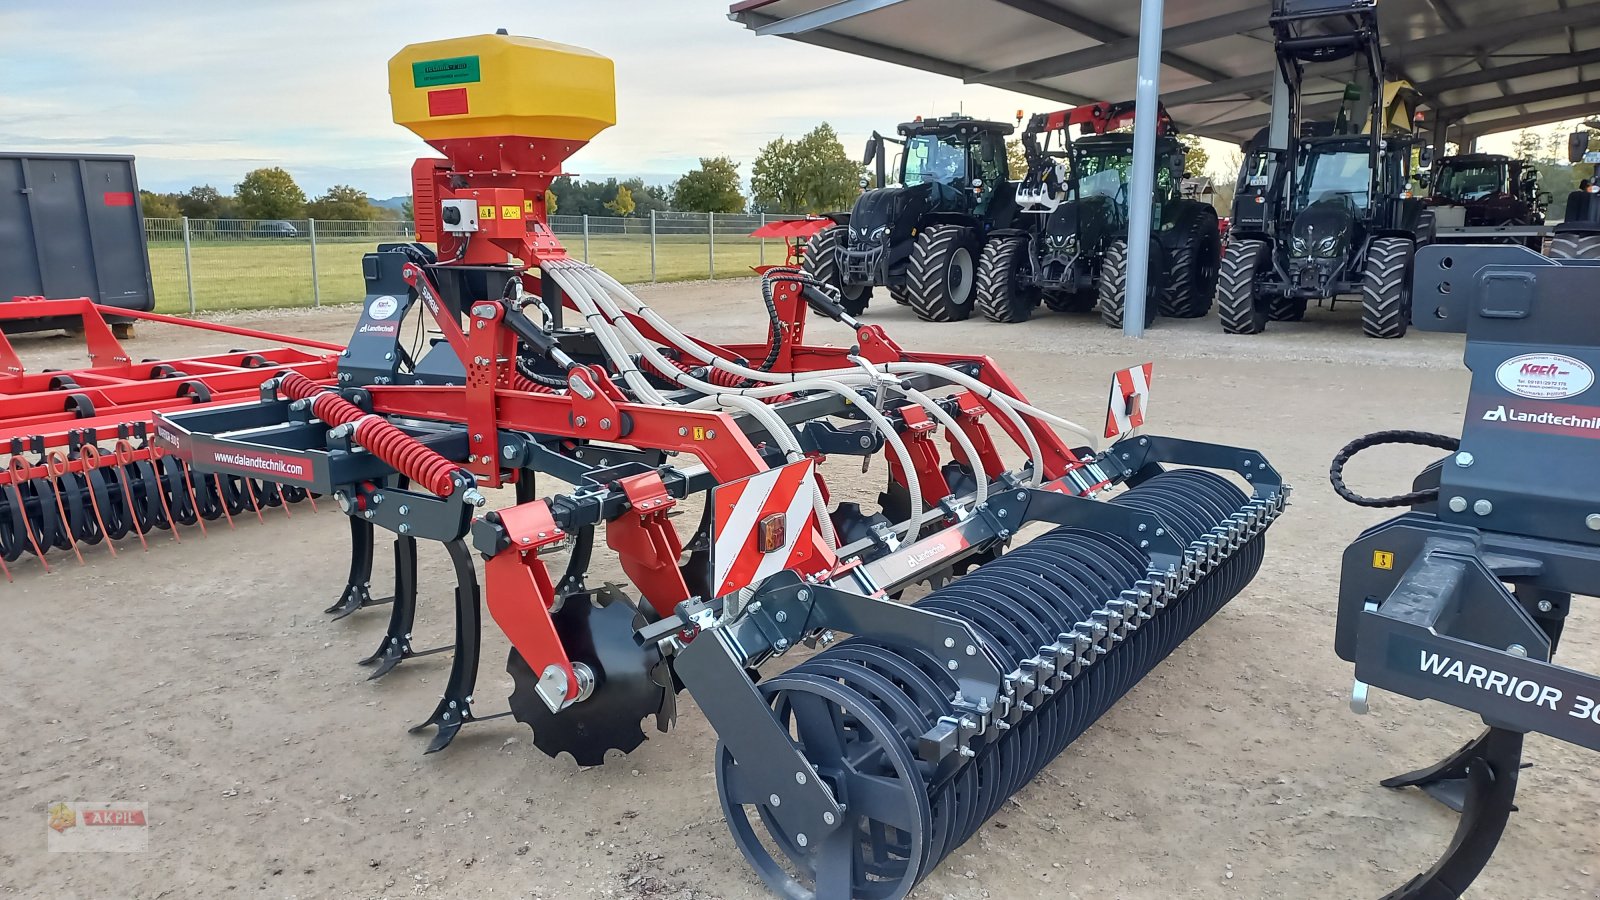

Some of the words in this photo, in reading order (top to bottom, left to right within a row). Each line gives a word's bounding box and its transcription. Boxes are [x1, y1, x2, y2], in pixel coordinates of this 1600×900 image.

[421, 285, 440, 316] SUPREME
[1520, 363, 1559, 375] Koch
[214, 452, 303, 475] www.dalandtechnik.com
[1420, 650, 1563, 711] WARRIOR
